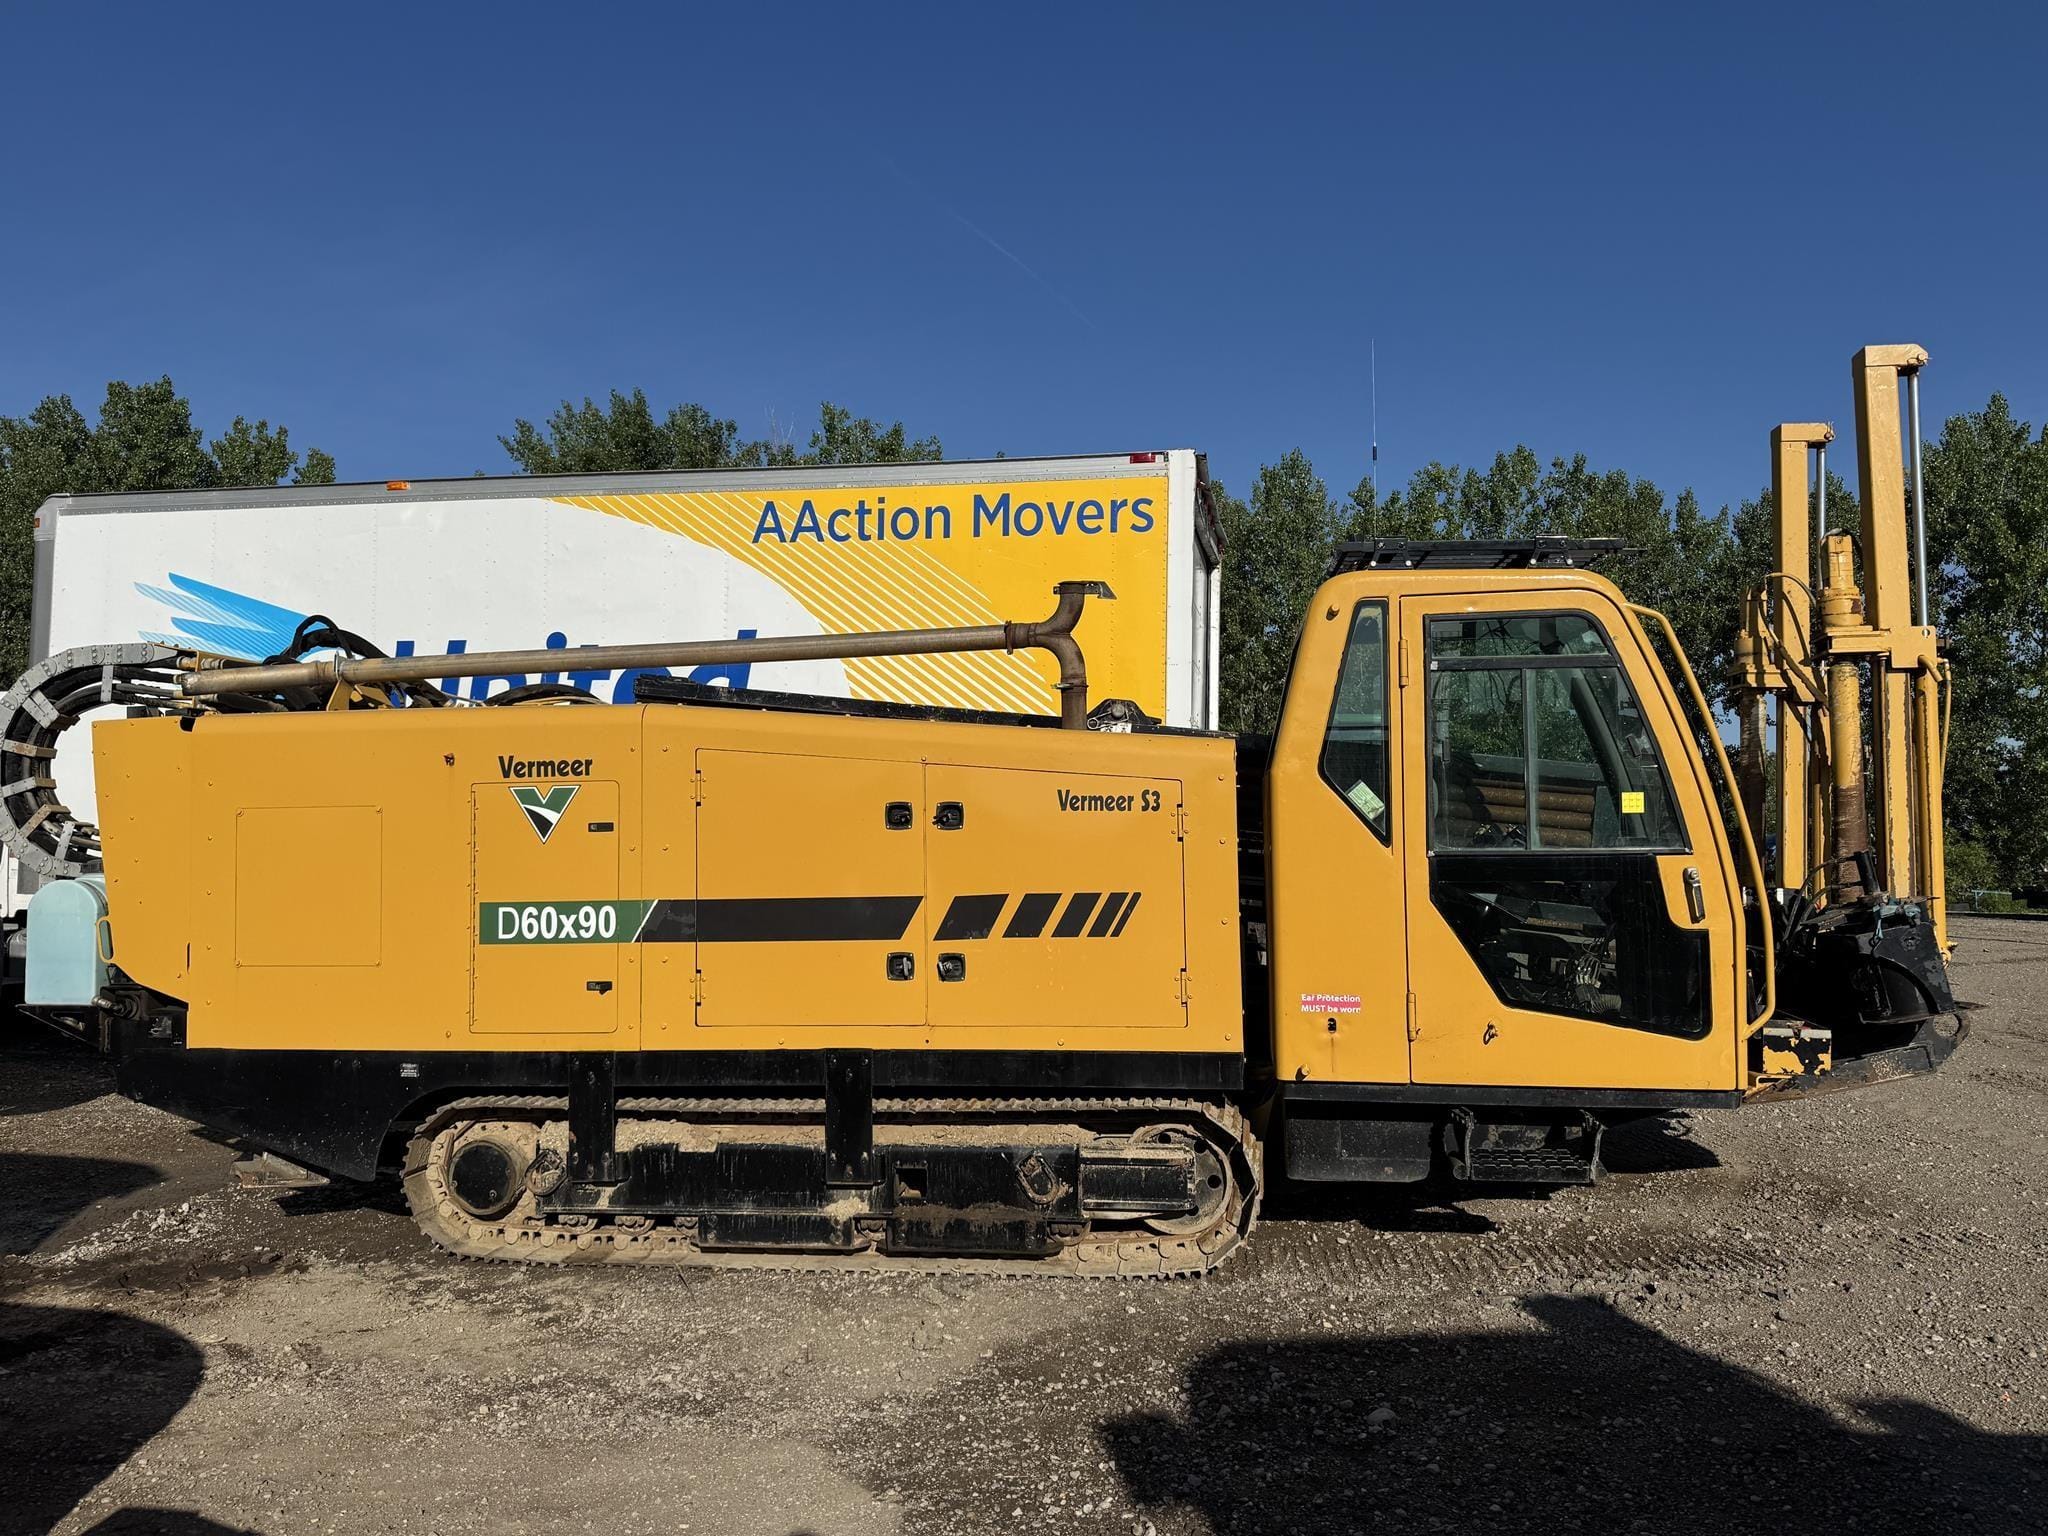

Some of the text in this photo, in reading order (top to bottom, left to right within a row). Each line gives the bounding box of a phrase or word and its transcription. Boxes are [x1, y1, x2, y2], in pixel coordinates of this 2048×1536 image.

[751, 493, 1155, 544] AAction Movers
[498, 755, 593, 779] Vermeer
[1057, 789, 1161, 812] Vermeer S3
[498, 905, 617, 940] D60x90
[1301, 993, 1361, 1002] Ear Protection
[1301, 1004, 1361, 1014] MUST be worn
